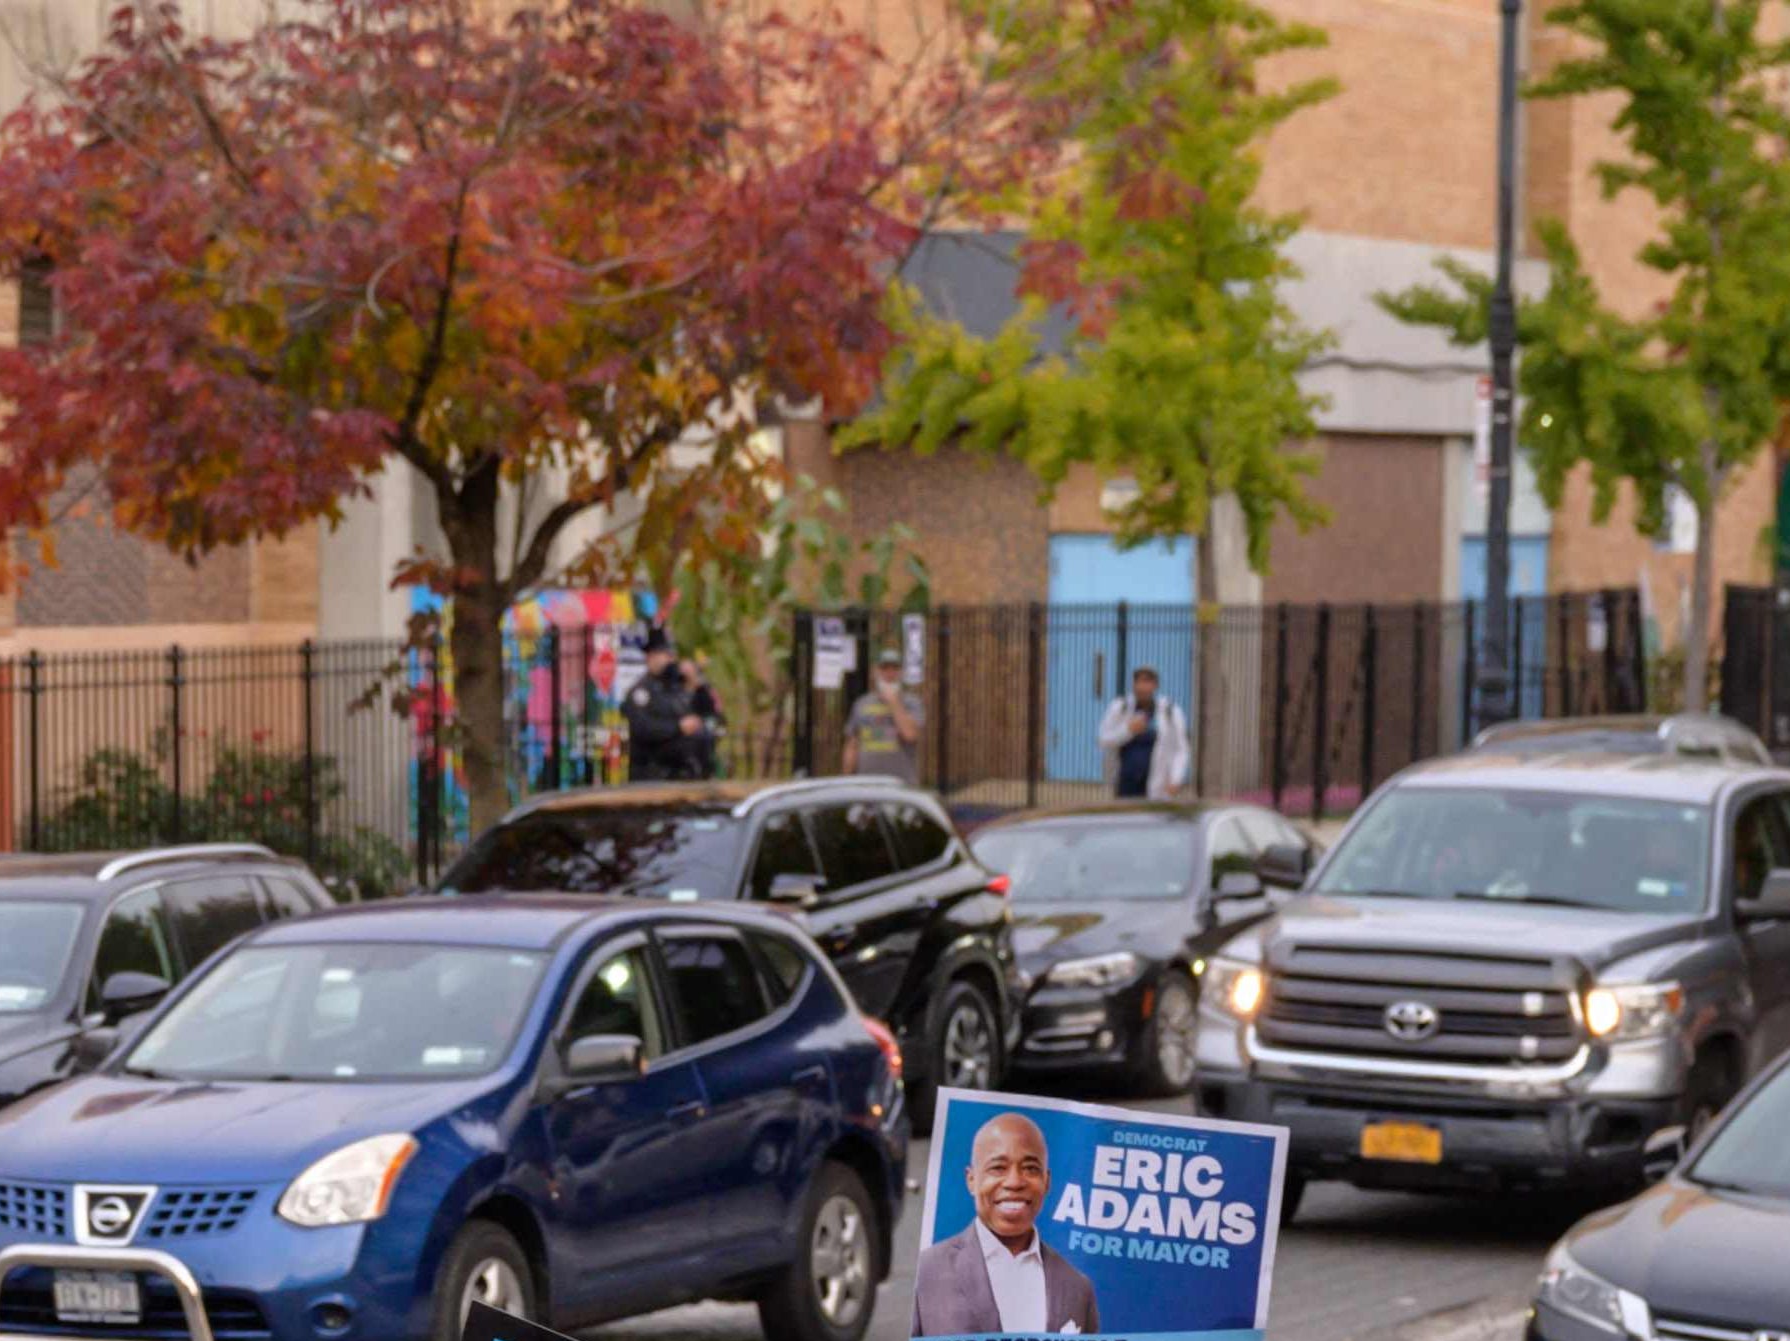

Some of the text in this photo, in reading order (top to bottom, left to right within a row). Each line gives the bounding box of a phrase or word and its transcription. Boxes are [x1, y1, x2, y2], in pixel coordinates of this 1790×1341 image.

[1112, 1130, 1208, 1153] DEMOCRAT
[1092, 1144, 1225, 1199] ERIC
[1051, 1182, 1257, 1246] ADAMS
[1067, 1229, 1231, 1270] FOR MAYOR
